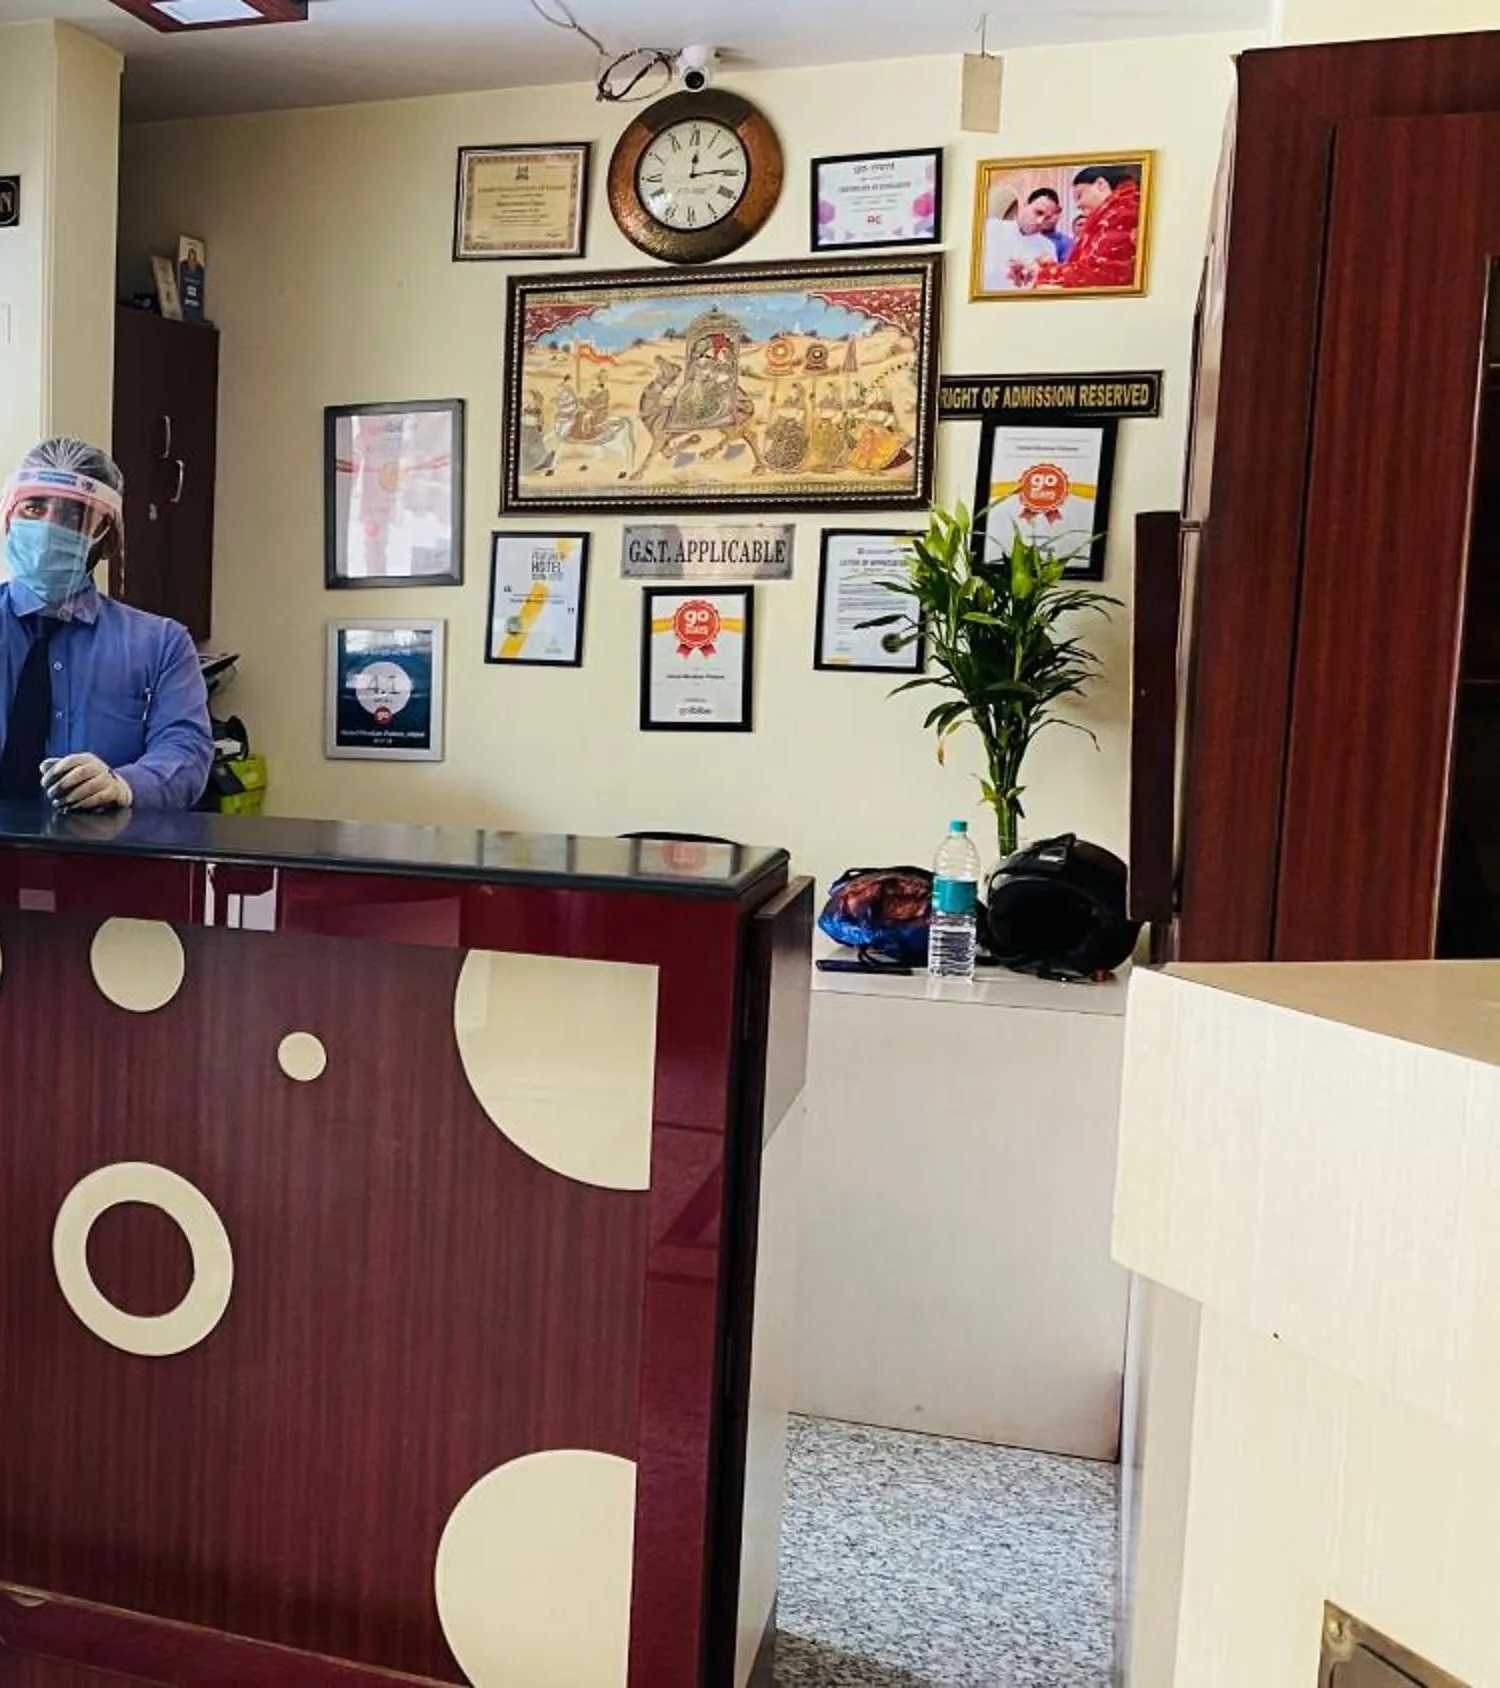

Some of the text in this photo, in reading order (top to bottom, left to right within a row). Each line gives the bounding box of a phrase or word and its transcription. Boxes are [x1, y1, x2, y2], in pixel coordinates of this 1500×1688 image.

[940, 383, 1150, 409] RIGHT OF ADMISSION RESERVED
[629, 539, 788, 563] G.S.T. APPLICABLE
